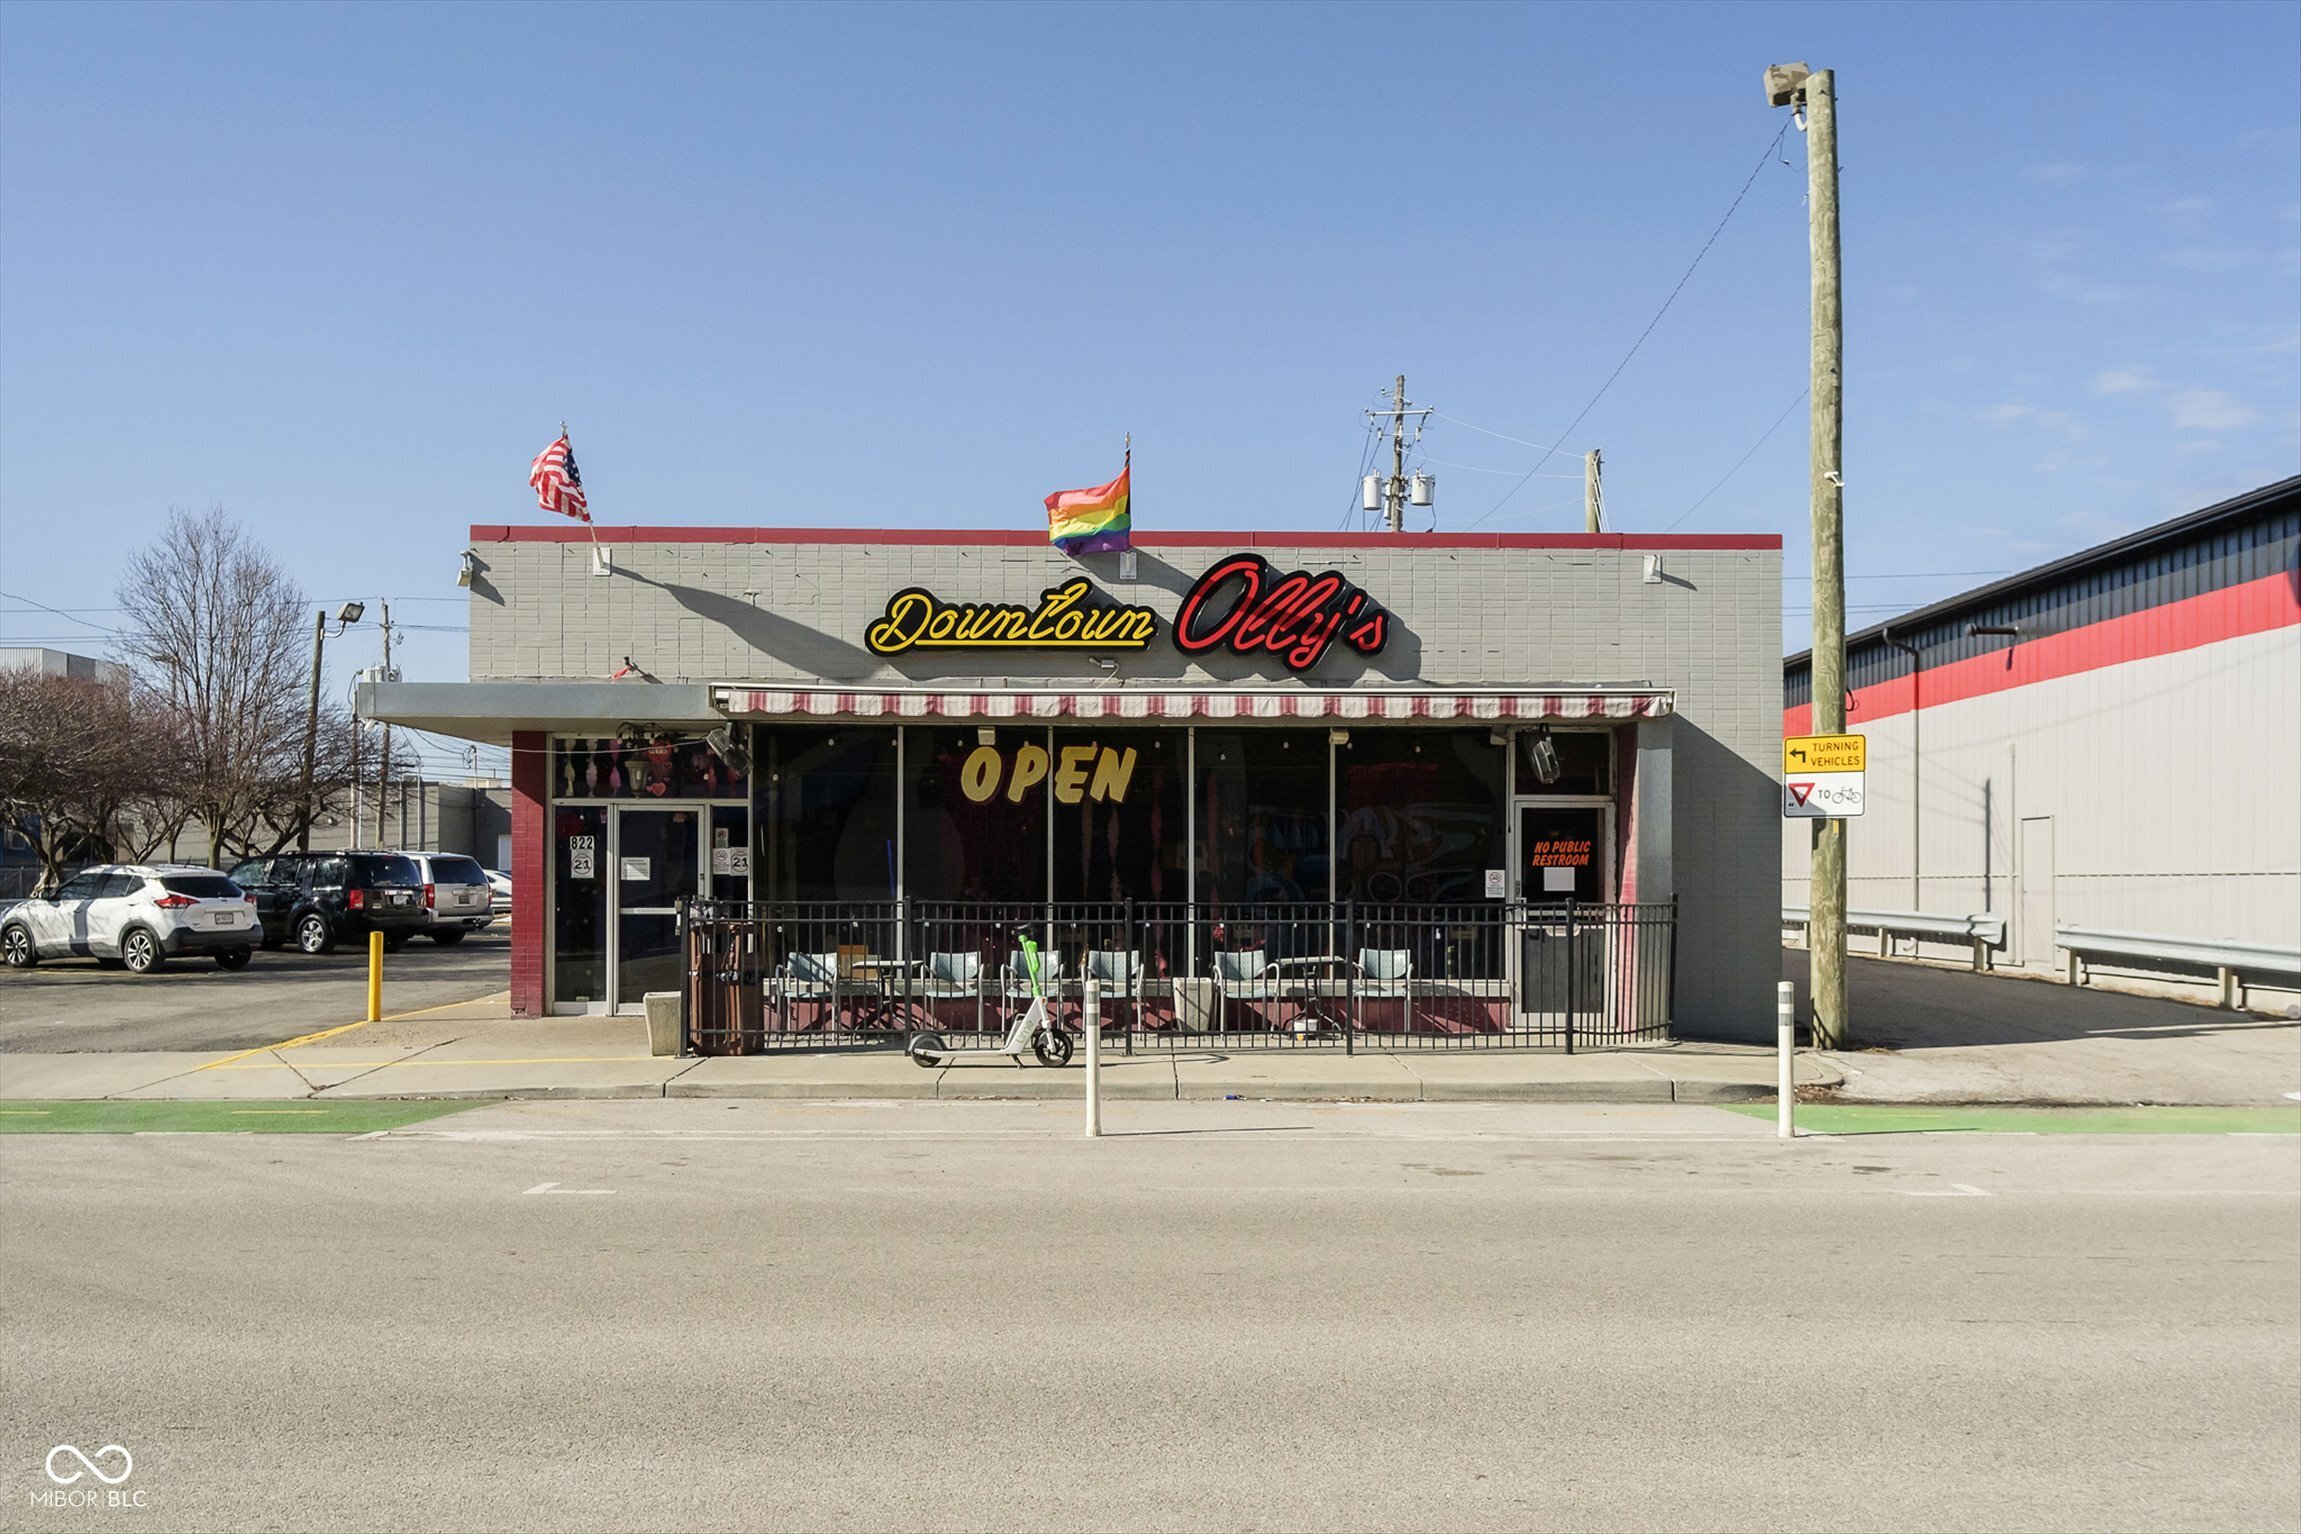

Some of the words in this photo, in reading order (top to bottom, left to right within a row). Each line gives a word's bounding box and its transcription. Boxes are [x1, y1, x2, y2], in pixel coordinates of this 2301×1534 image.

[870, 583, 1153, 652] Downtown
[1178, 561, 1383, 668] Olly's
[1813, 741, 1859, 752] TURNING
[1811, 756, 1860, 766] VEHICLES
[961, 746, 1137, 803] OPEN
[1818, 789, 1831, 799] TO
[571, 836, 593, 849] 822
[1534, 841, 1550, 853] NO
[1552, 840, 1591, 853] PUBLIC
[574, 860, 590, 869] 21
[733, 857, 748, 867] 21
[1532, 854, 1589, 866] RESTROOM
